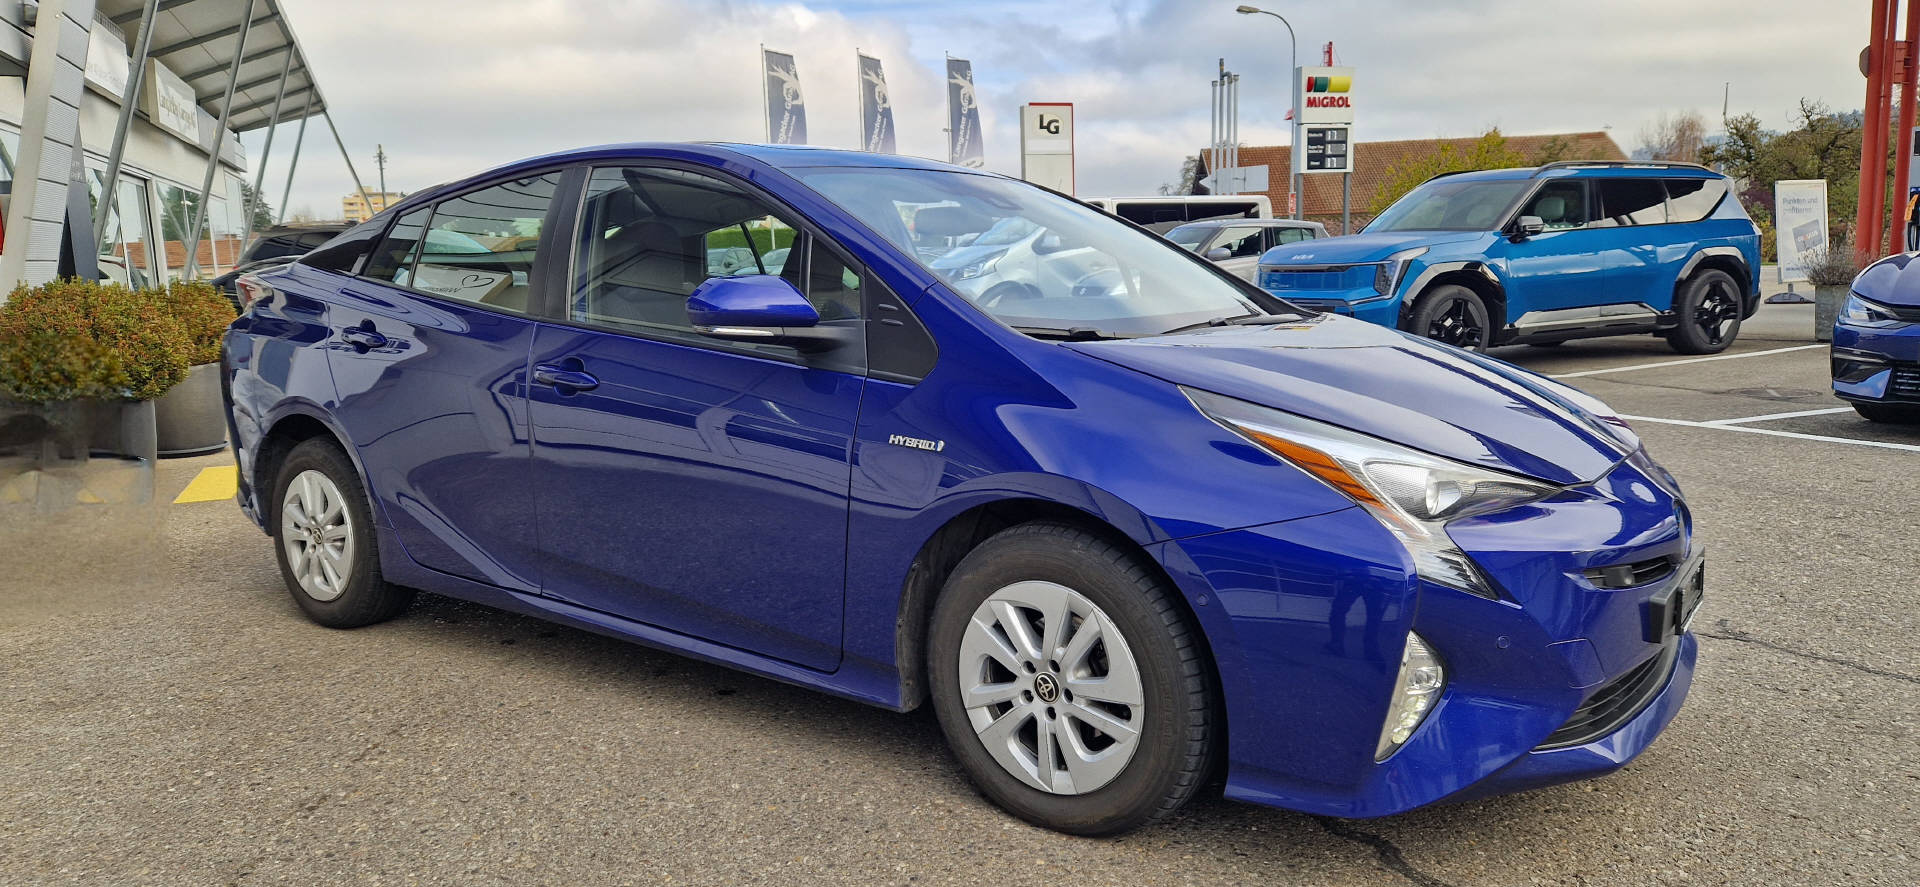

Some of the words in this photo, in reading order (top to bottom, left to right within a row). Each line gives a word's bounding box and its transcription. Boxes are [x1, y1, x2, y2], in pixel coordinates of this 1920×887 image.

[1306, 96, 1350, 108] MIGROL
[1039, 114, 1060, 135] LG
[889, 434, 936, 451] HYBRID
